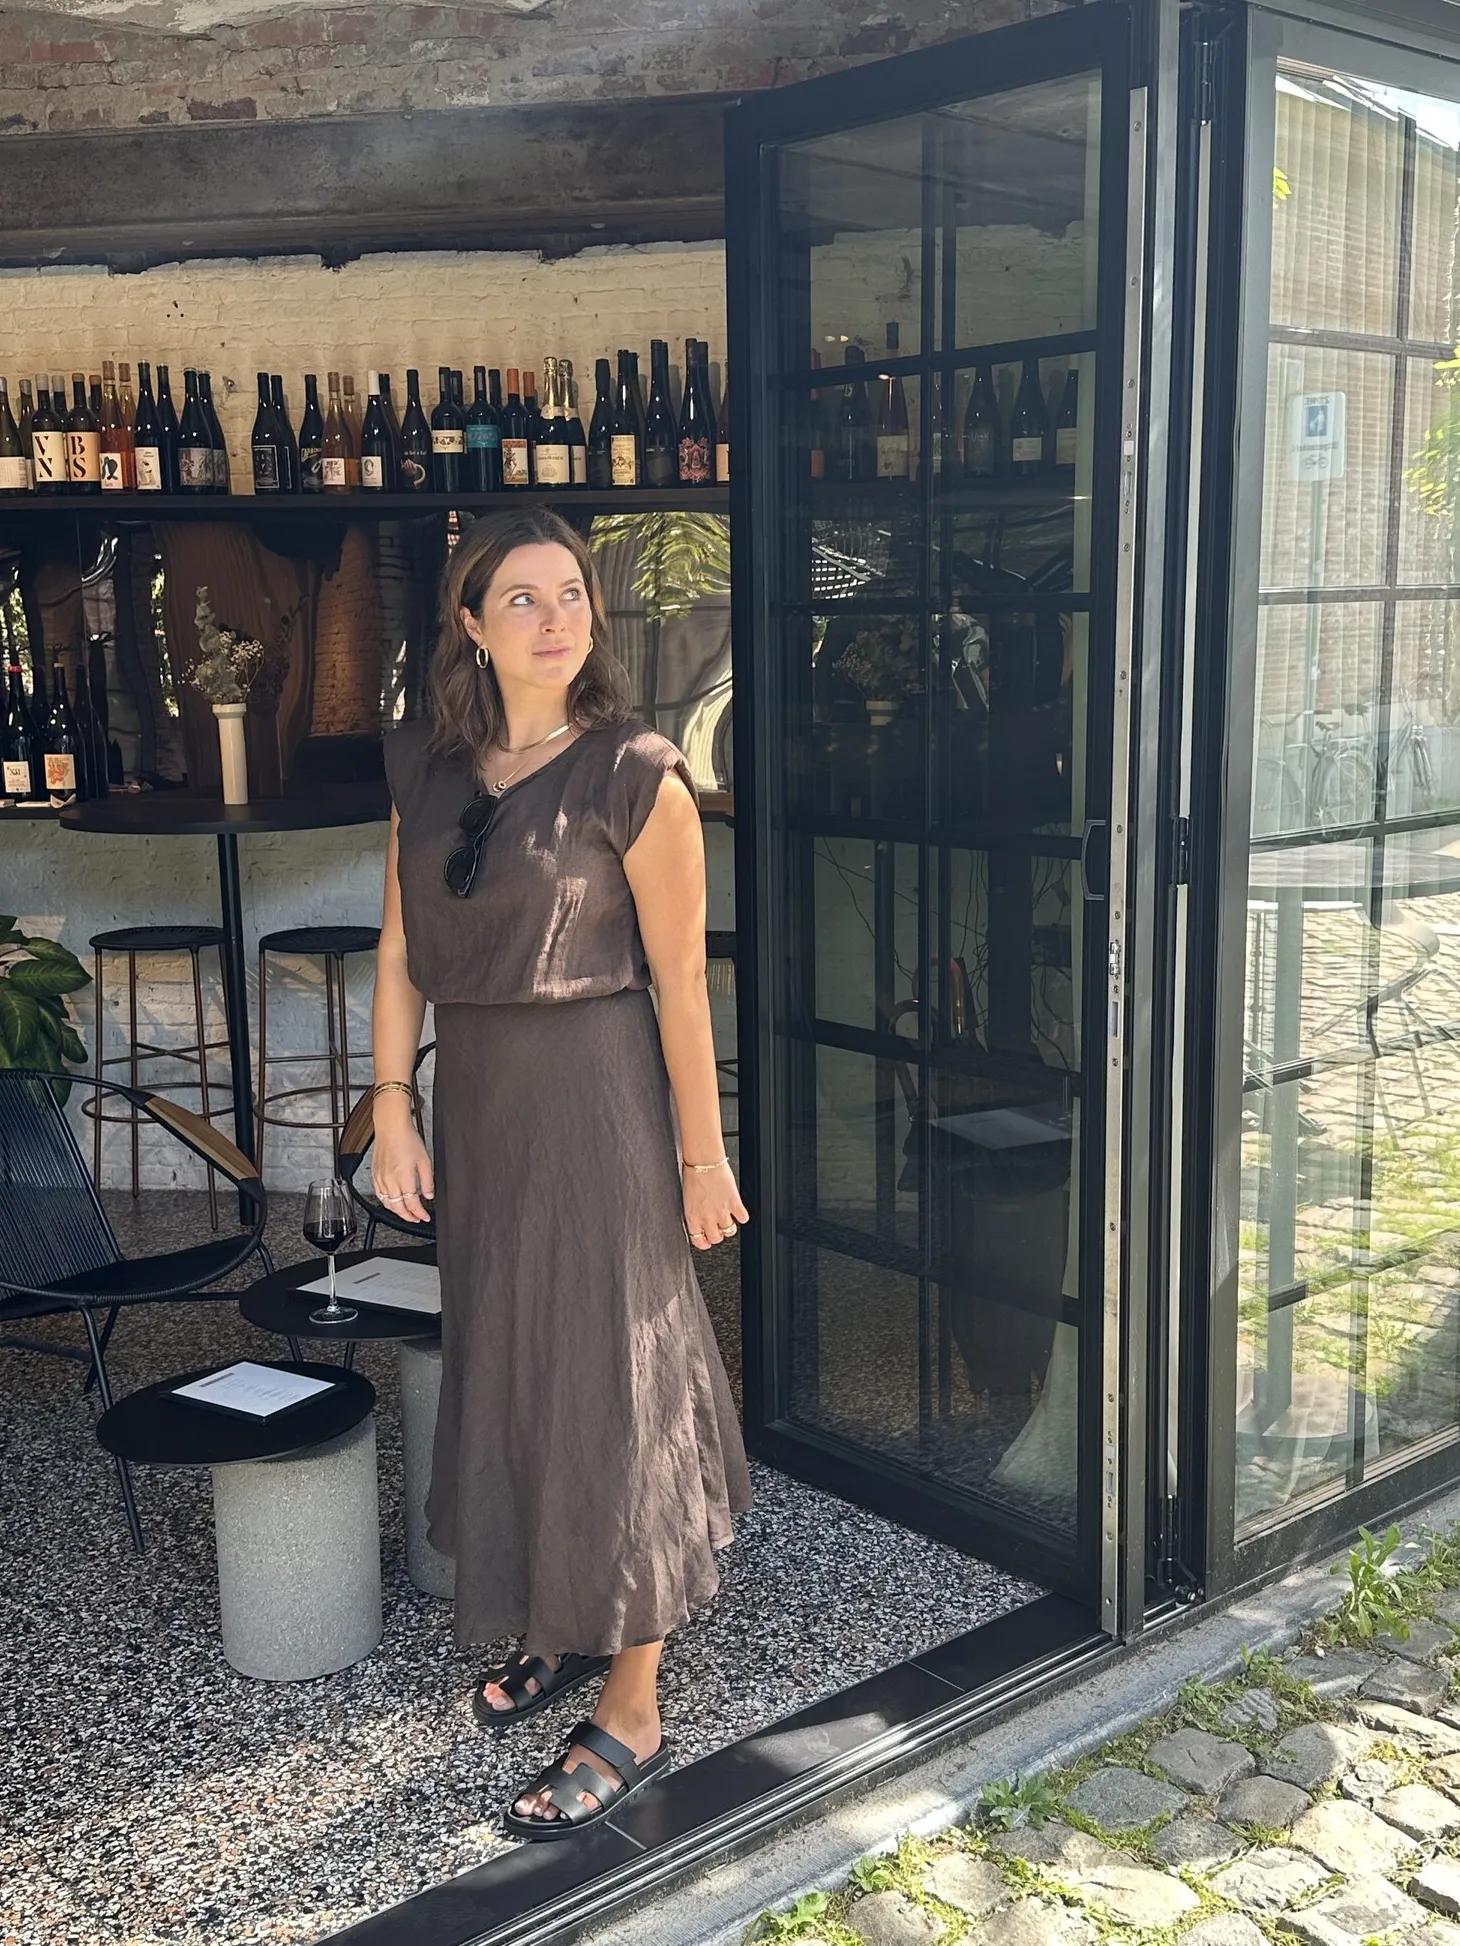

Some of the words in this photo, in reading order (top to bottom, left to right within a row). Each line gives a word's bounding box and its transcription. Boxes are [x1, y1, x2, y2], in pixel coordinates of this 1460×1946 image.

[34, 435, 49, 456] V
[70, 435, 86, 455] B
[37, 457, 53, 478] N
[72, 457, 87, 478] S
